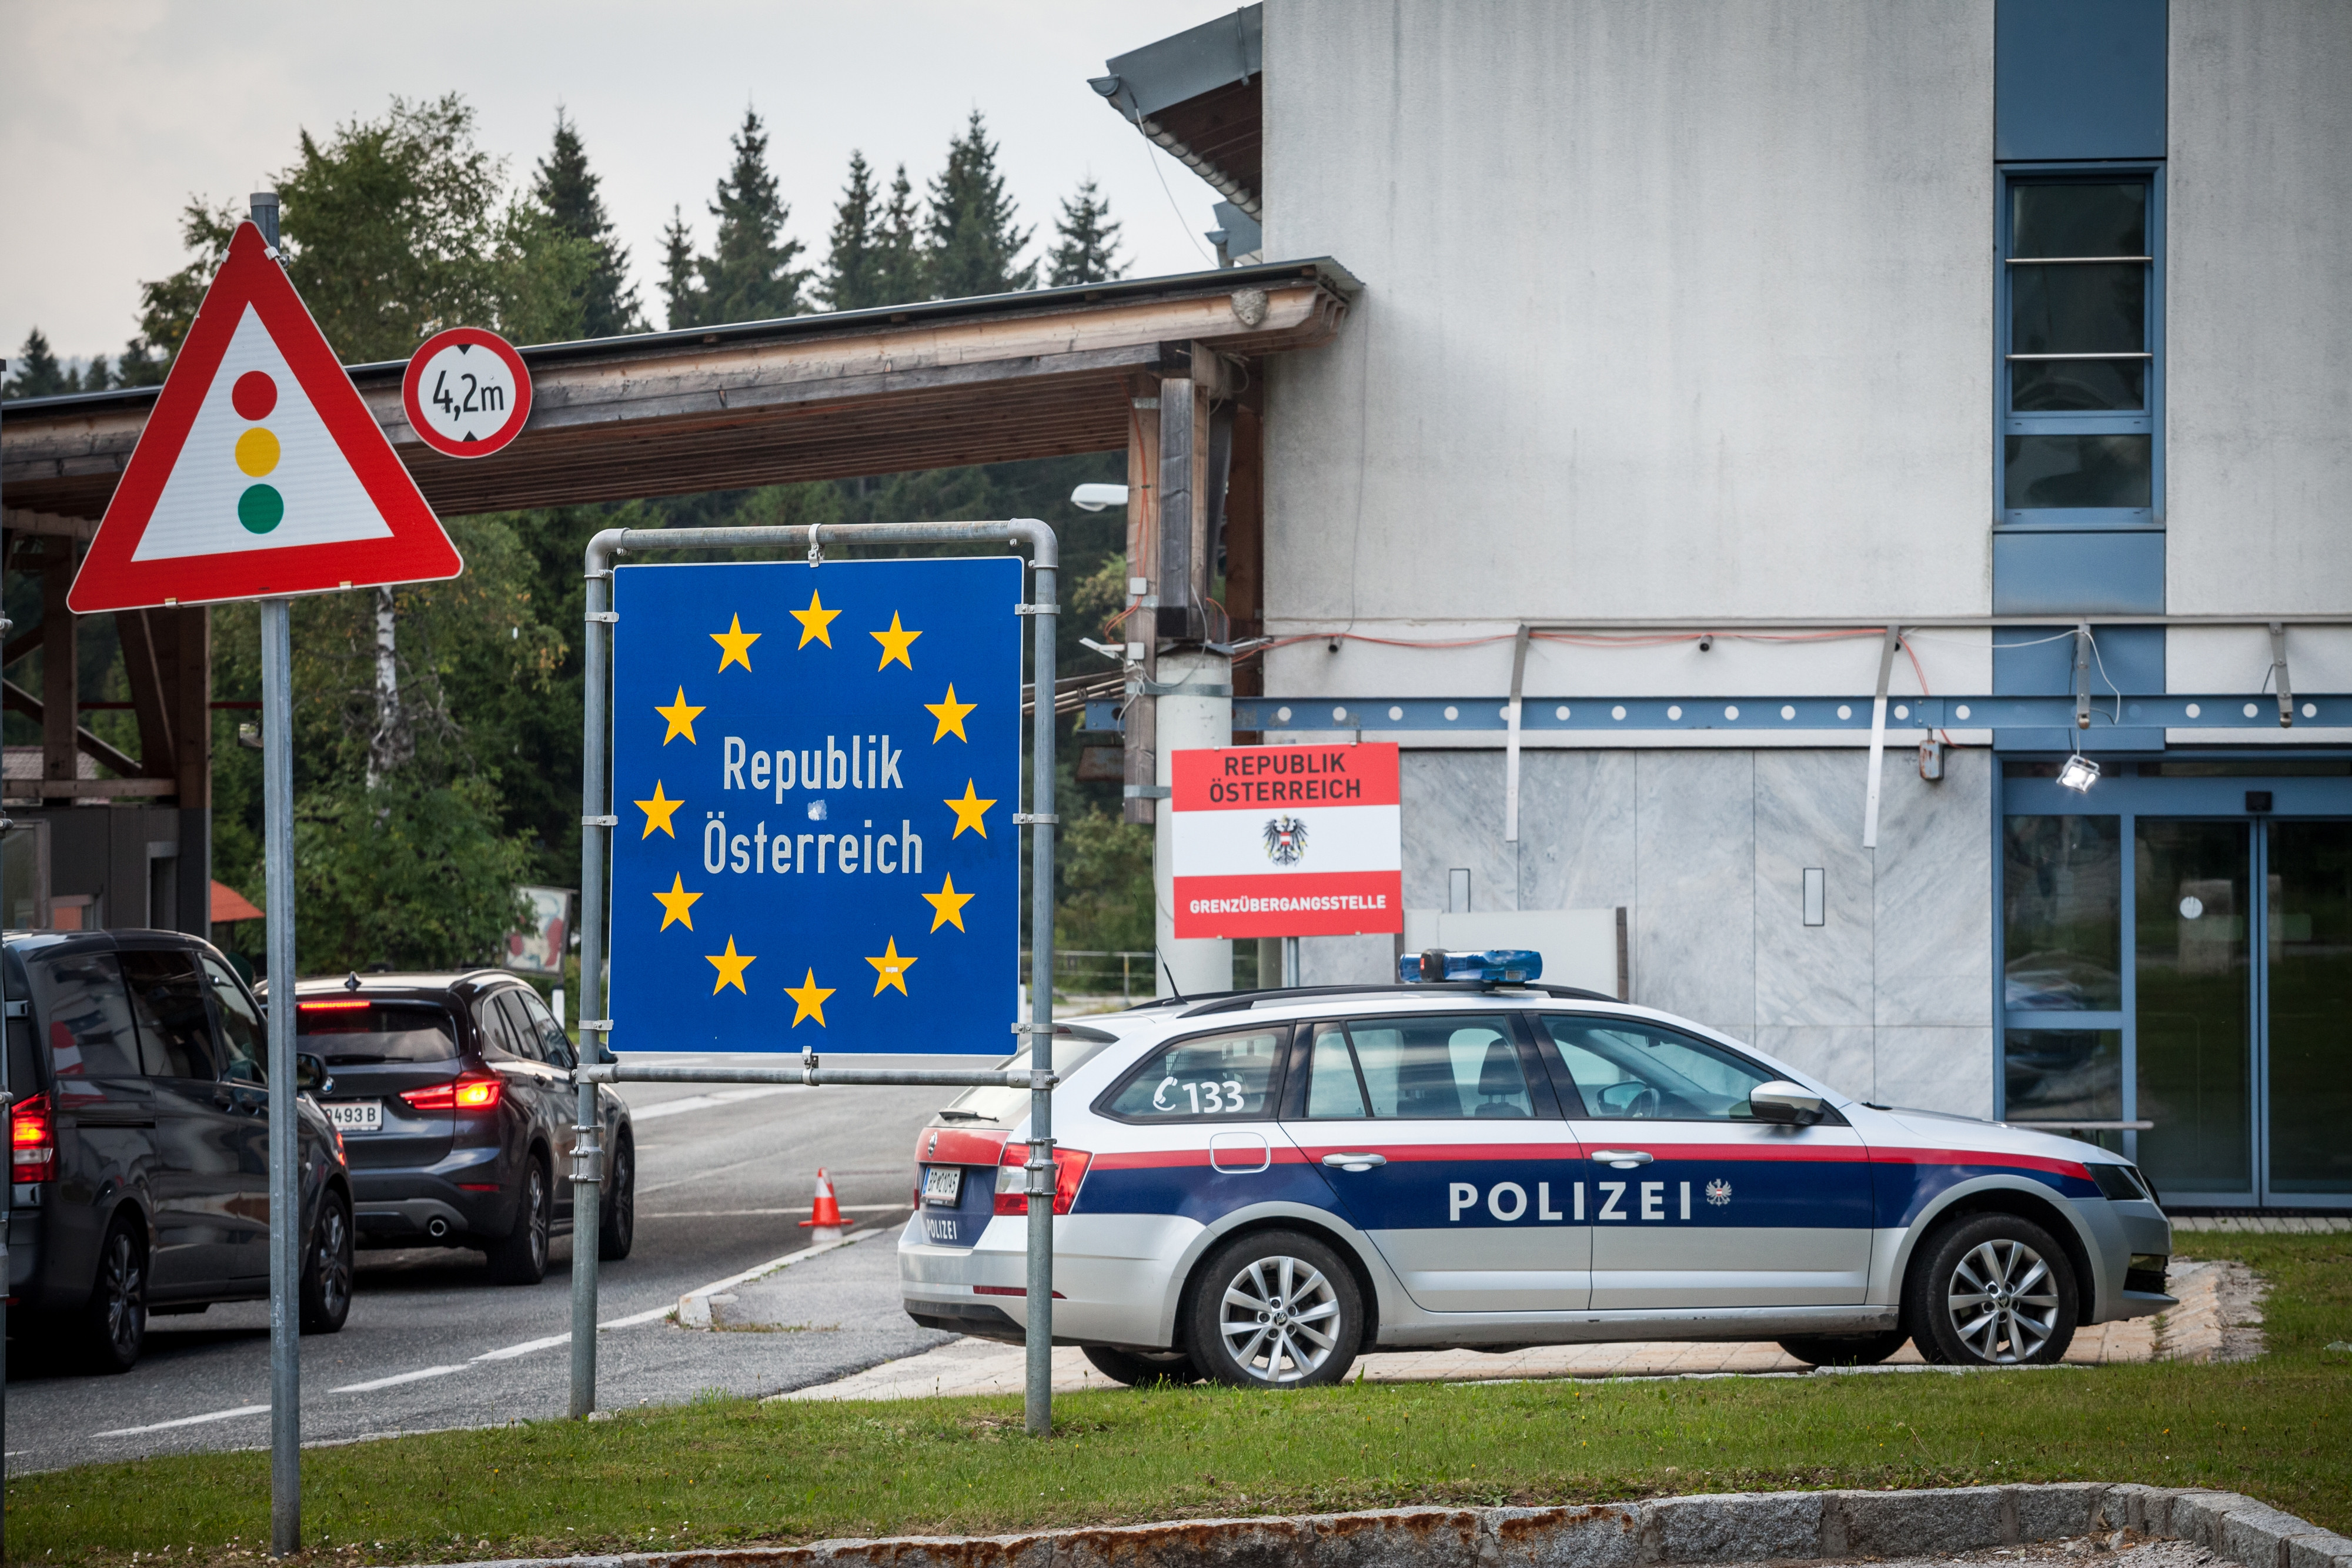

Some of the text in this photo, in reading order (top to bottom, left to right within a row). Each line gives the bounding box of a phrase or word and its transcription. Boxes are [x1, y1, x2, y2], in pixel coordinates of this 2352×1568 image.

[433, 370, 505, 422] 4,2m
[724, 735, 903, 804] Republik
[1225, 753, 1345, 776] REPUBLIK
[1210, 778, 1361, 803] ÖSTERREICH
[704, 811, 923, 874] Österreich
[1190, 895, 1386, 914] GRENZÜBERGANGSSTELLE
[1182, 1081, 1244, 1114] 133
[368, 1107, 376, 1122] B
[928, 1171, 937, 1192] BP
[1449, 1182, 1691, 1221] POLIZEI
[927, 1218, 957, 1240] POLIZEI
